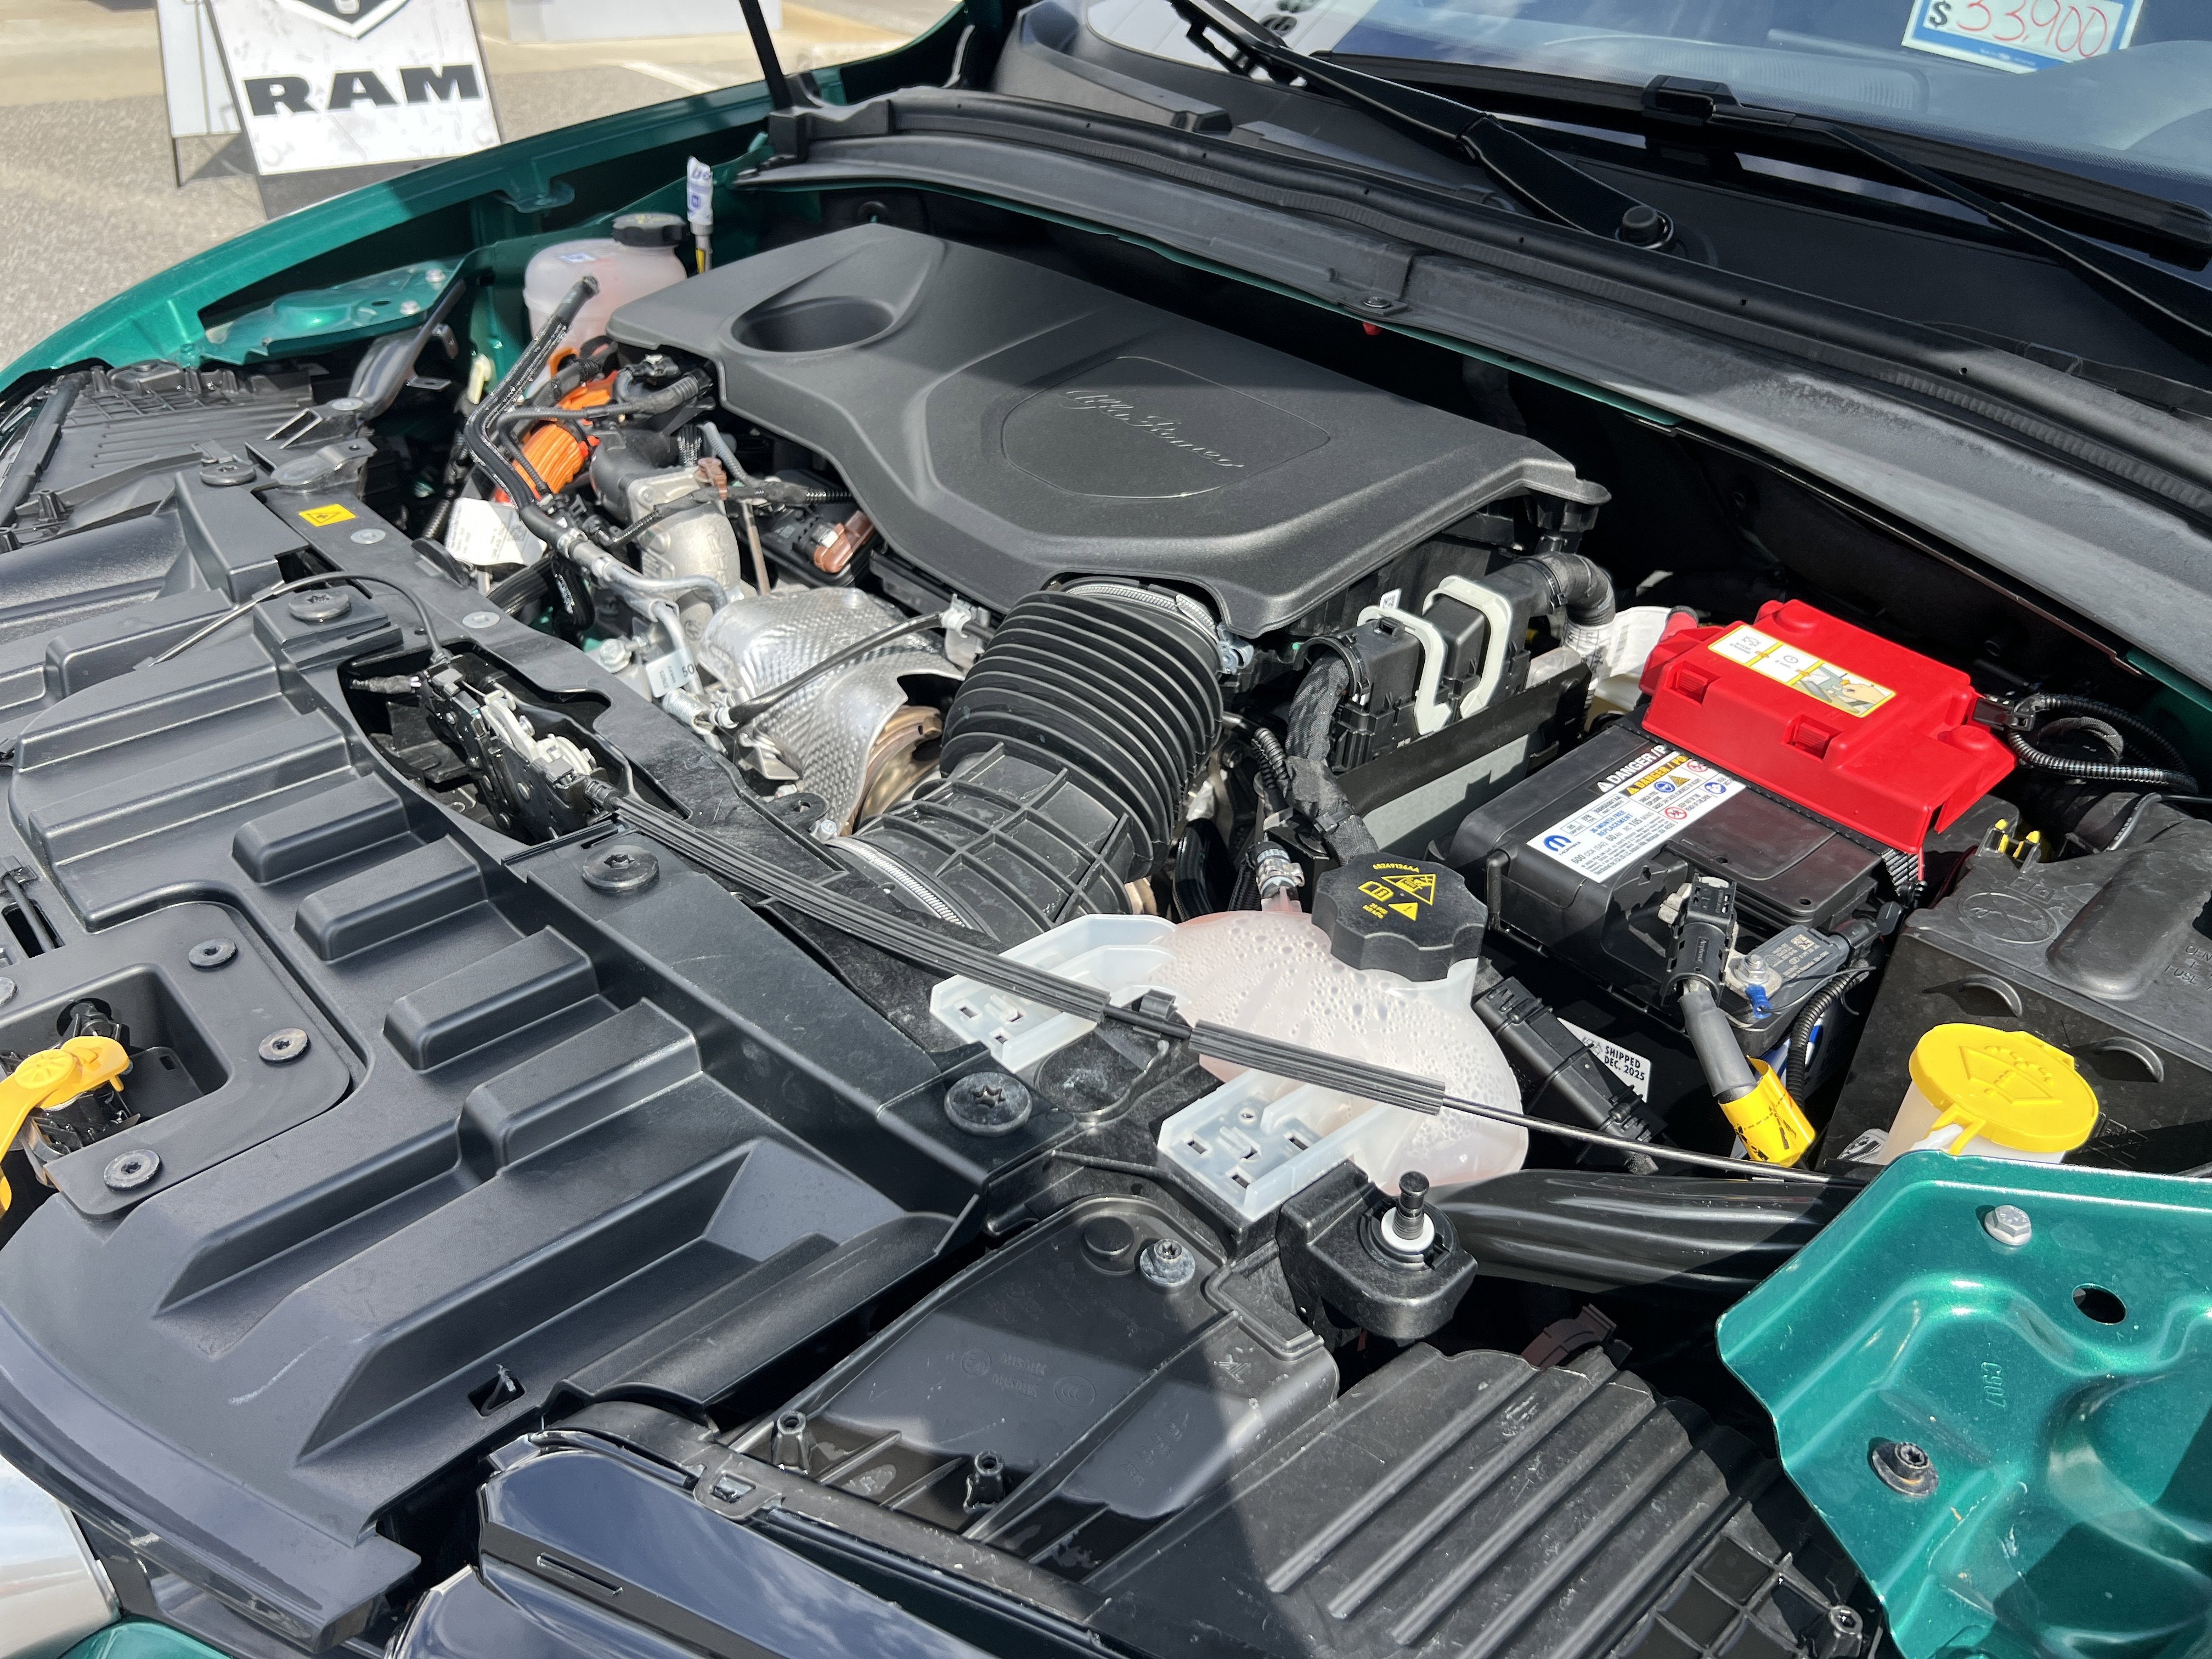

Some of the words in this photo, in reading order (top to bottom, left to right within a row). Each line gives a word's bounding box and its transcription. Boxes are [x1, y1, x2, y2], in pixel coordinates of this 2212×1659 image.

[1929, 1, 1951, 27] $
[243, 64, 483, 117] RAM
[1634, 766, 1671, 788] DANGER
[1596, 813, 1633, 837] REPLACEMENT
[1570, 854, 1586, 864] 600
[1628, 817, 1643, 827] 105
[1604, 1055, 1621, 1071] DEC.
[1624, 1065, 1645, 1081] 2025
[1605, 1046, 1640, 1068] SHIPPED
[1981, 1361, 2007, 1408] C907
